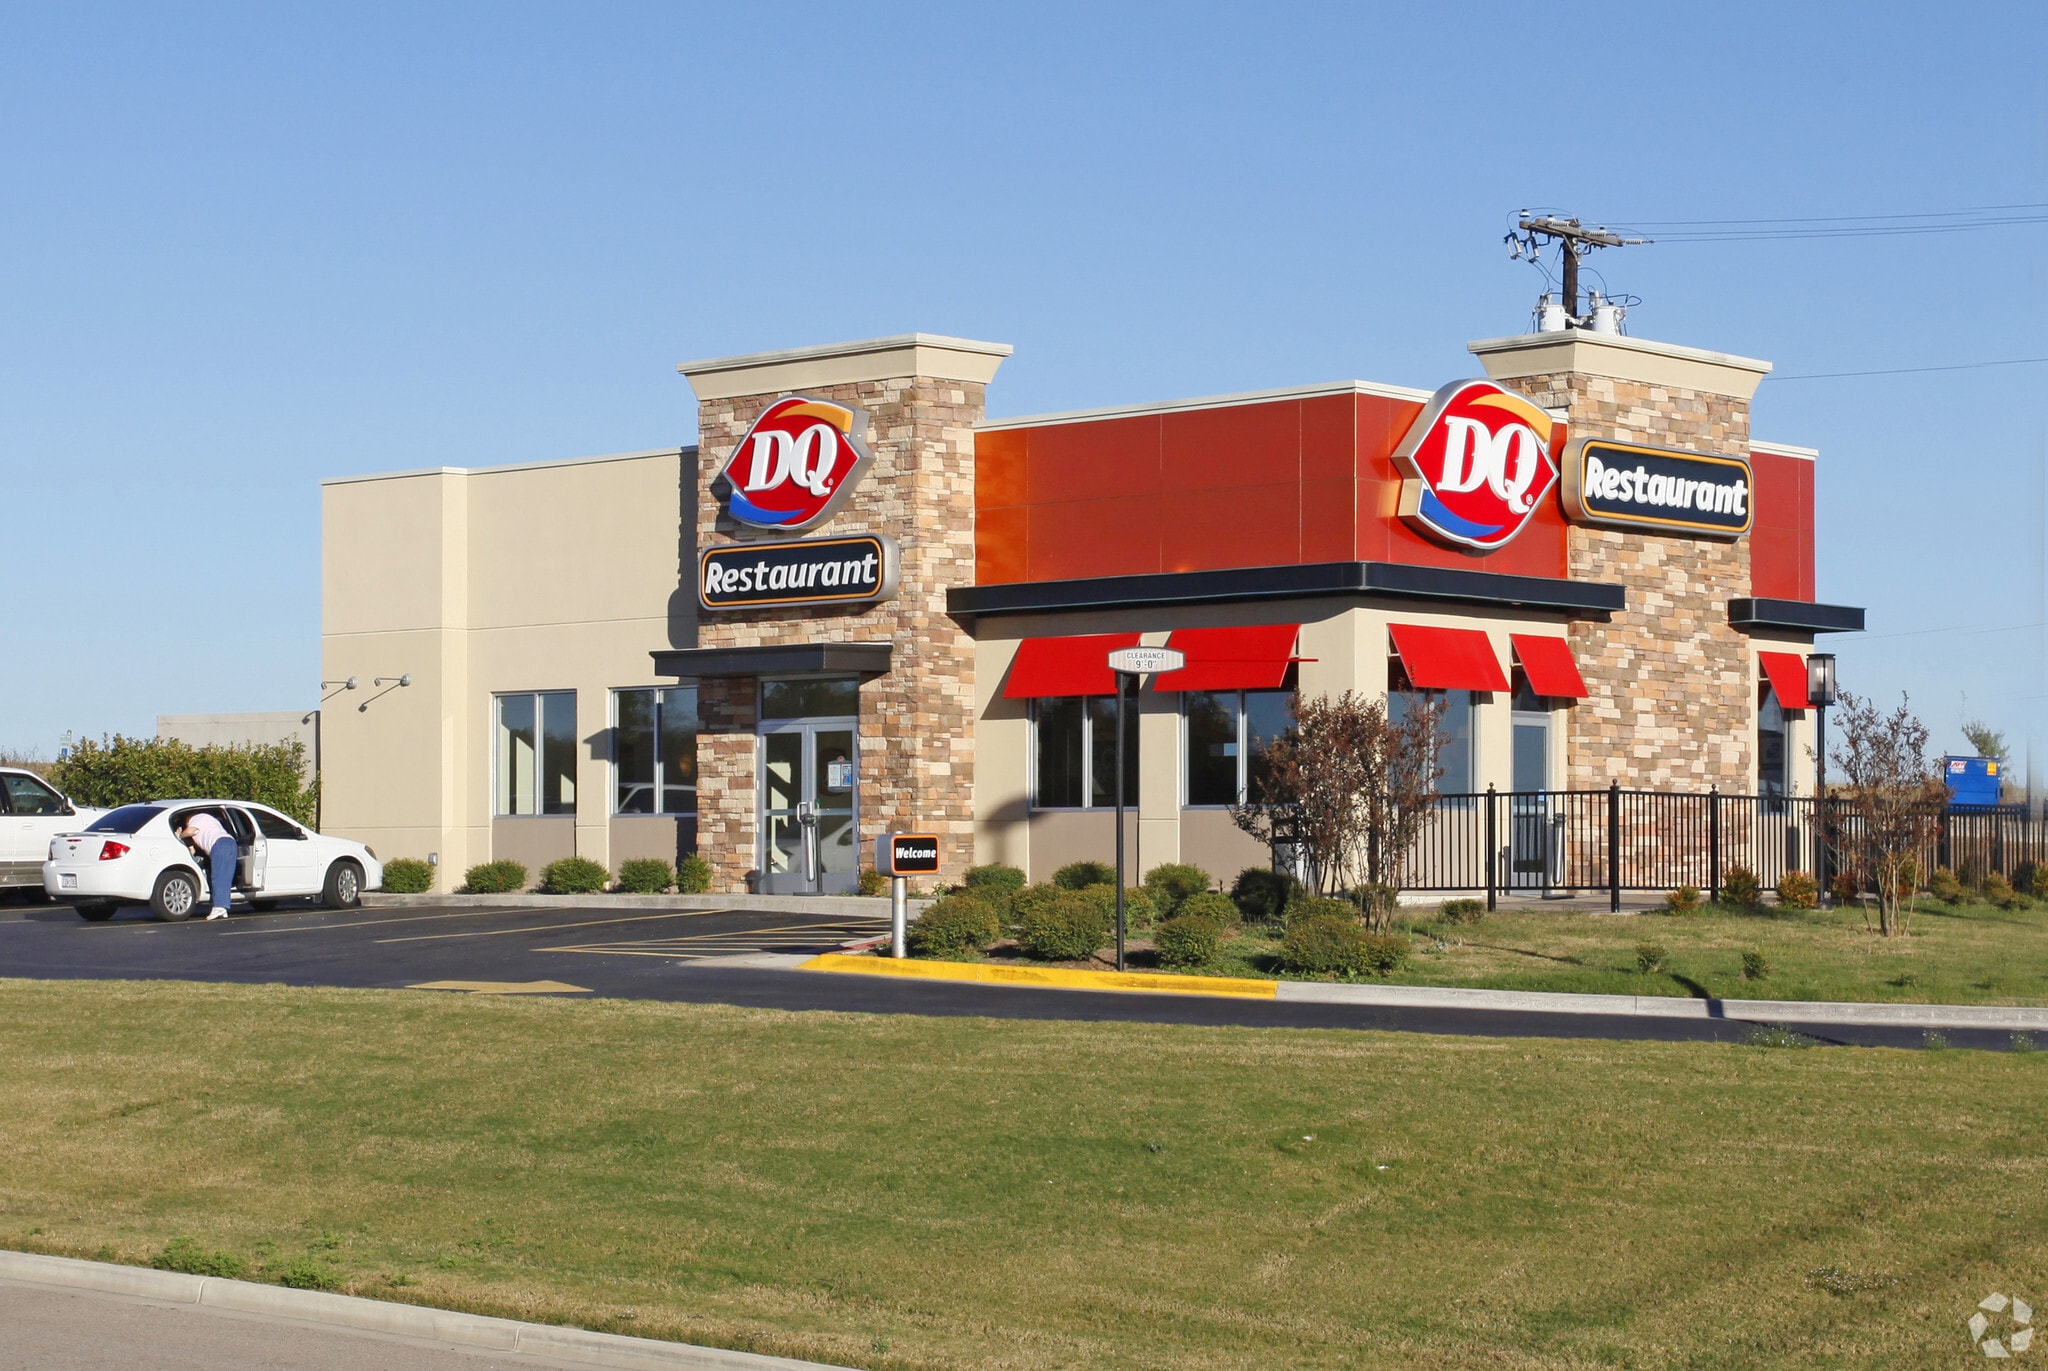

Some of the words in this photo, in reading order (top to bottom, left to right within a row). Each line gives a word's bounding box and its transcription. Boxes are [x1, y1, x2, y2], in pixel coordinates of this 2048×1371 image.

[744, 424, 838, 497] DQ
[1436, 415, 1538, 514] DQ
[1584, 456, 1749, 516] Restaurant
[705, 553, 878, 594] Restaurant
[1126, 652, 1166, 660] CLEARANCE
[895, 846, 937, 859] Welcome
